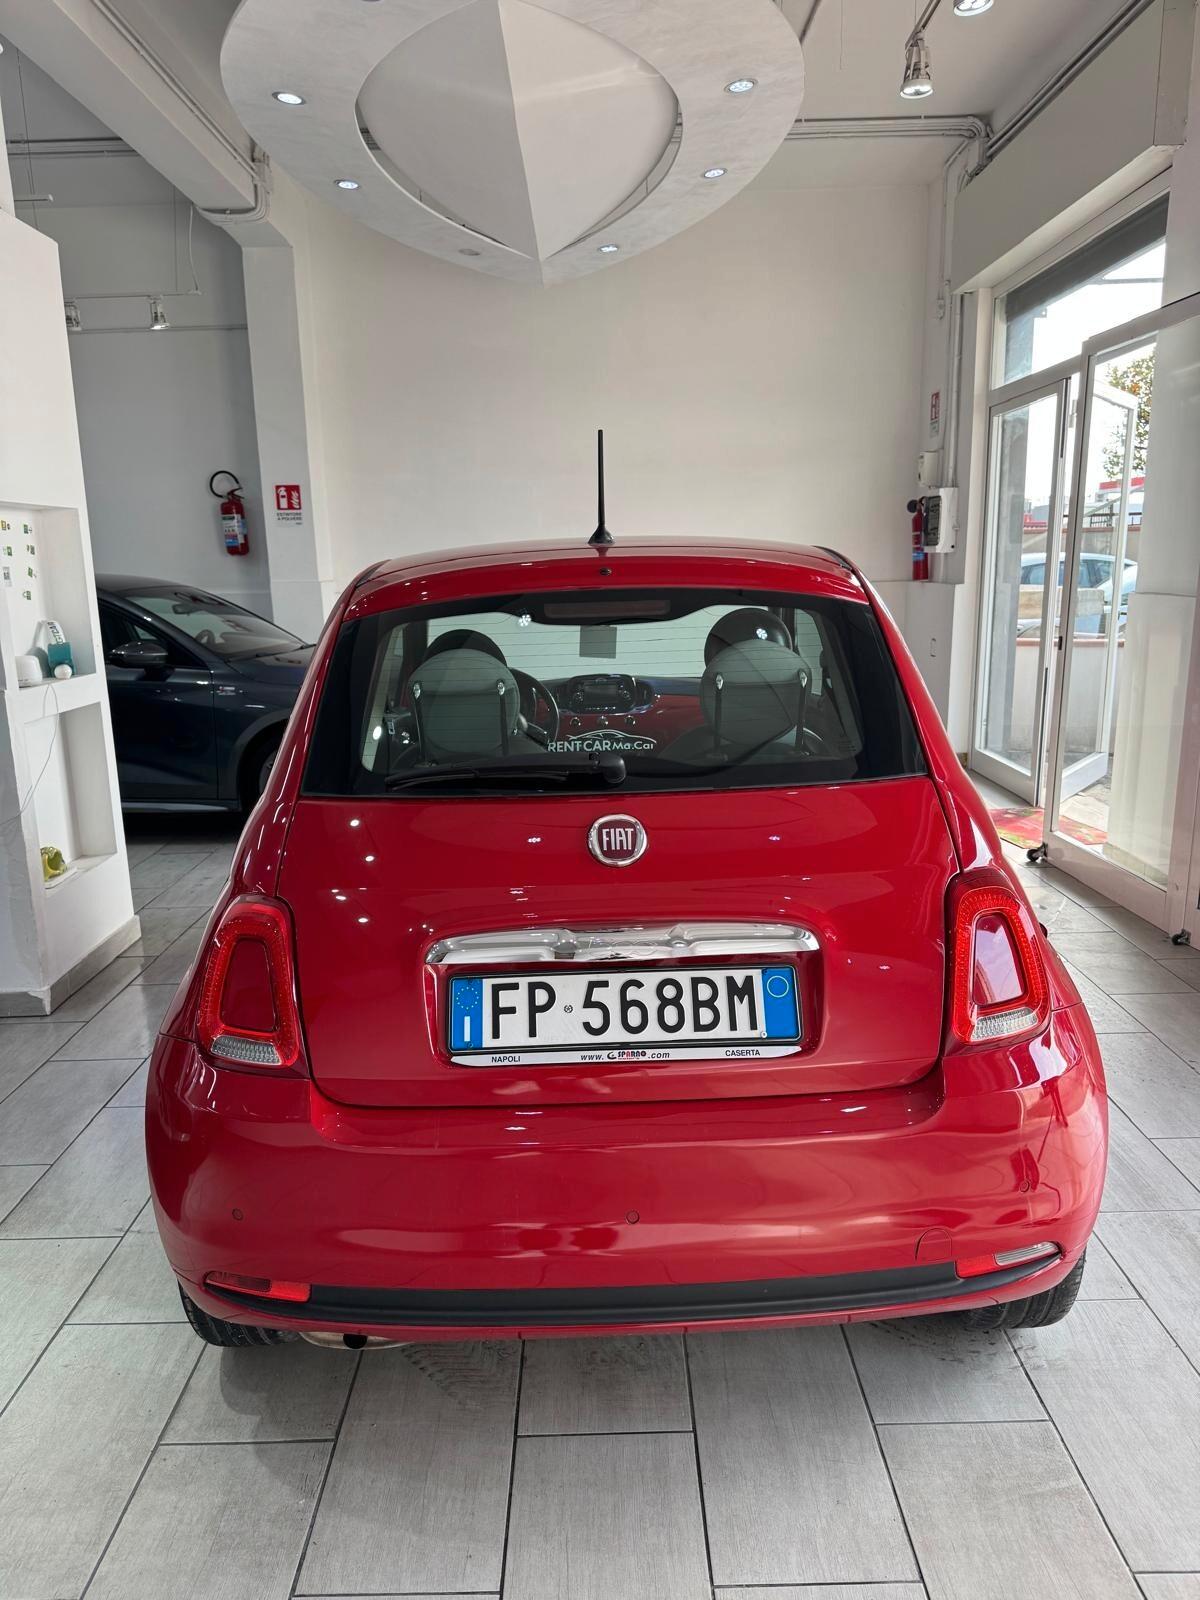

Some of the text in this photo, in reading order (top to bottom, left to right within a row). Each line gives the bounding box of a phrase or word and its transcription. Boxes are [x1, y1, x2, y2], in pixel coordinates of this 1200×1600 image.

[602, 828, 634, 851] FIAT
[491, 975, 758, 1040] FP 568BM
[491, 1055, 521, 1063] NAPOLI
[725, 1049, 761, 1058] CASERTA
